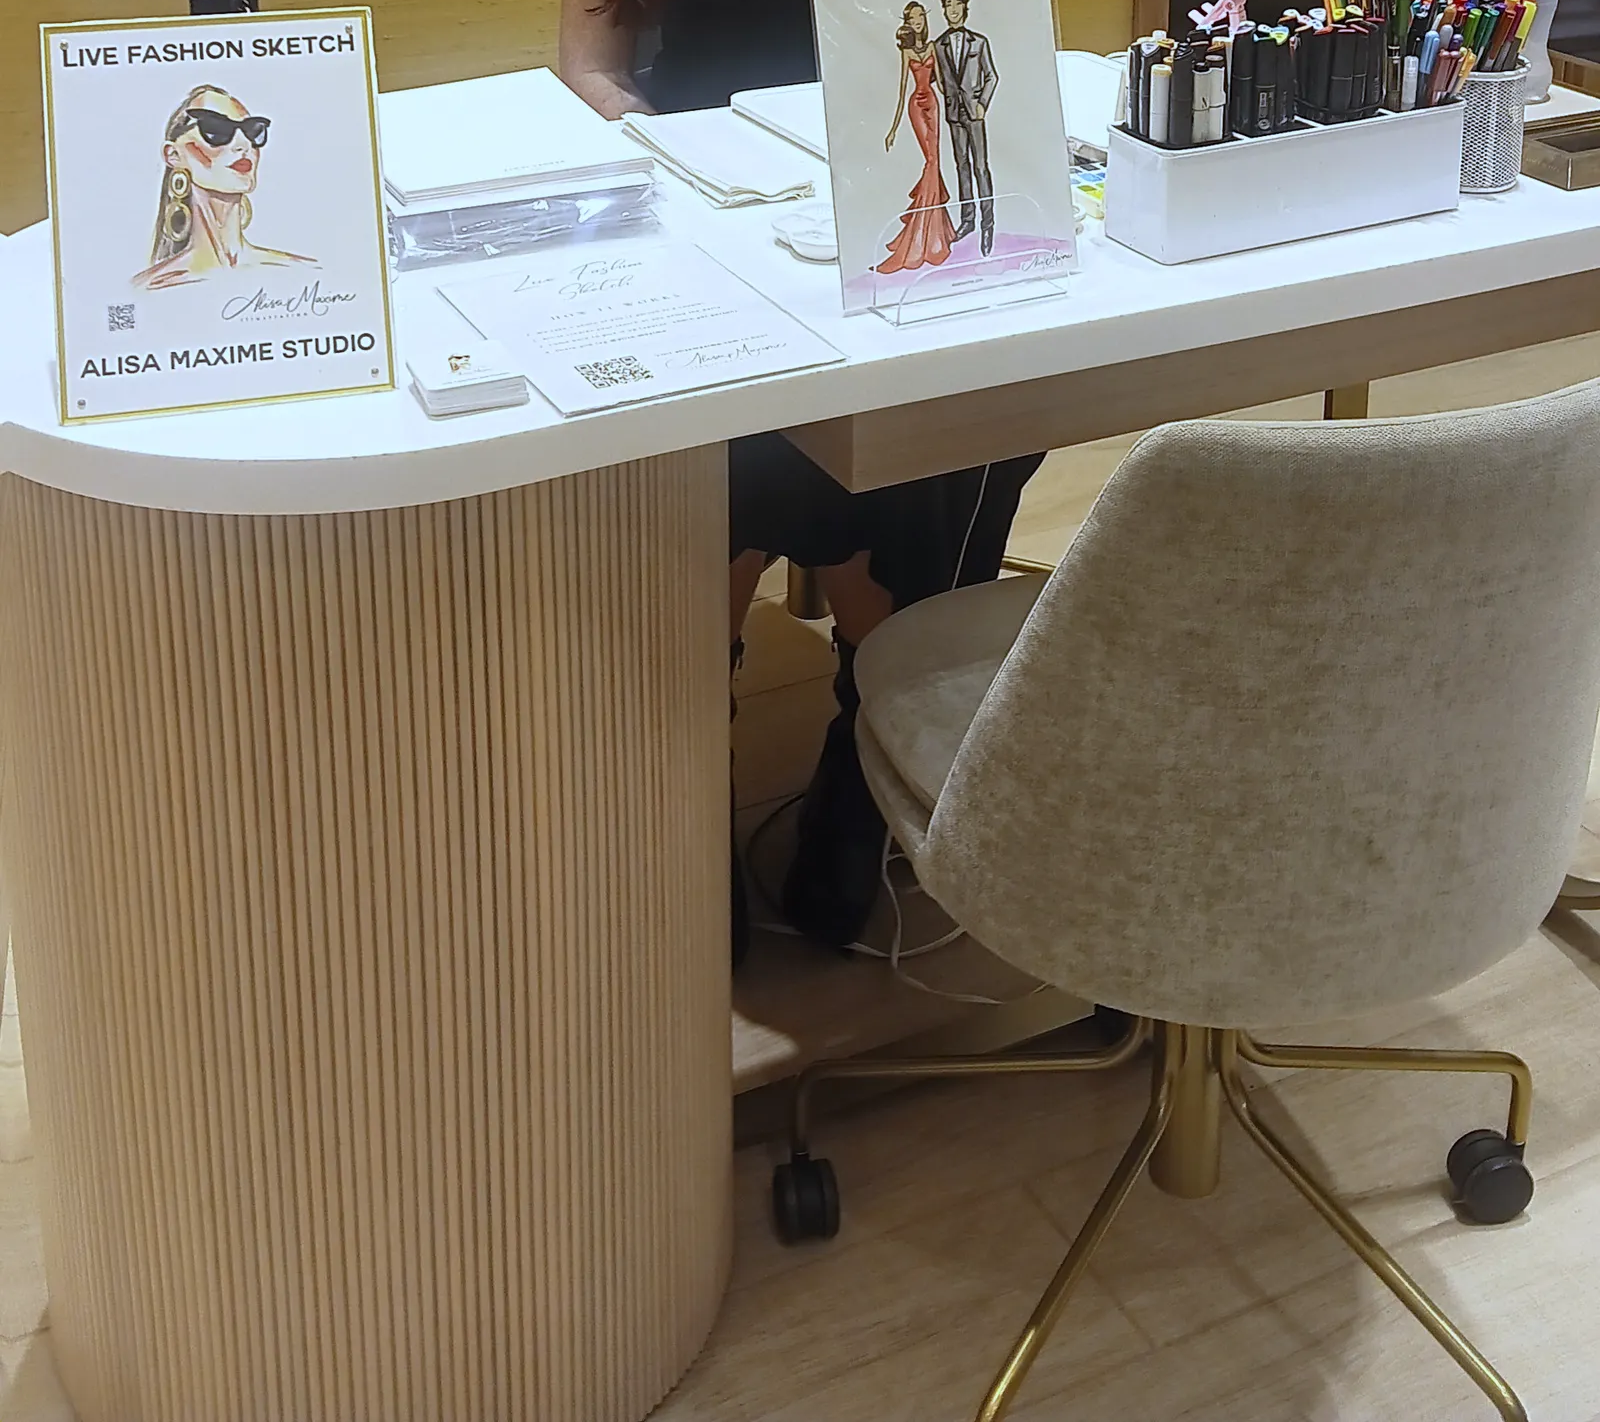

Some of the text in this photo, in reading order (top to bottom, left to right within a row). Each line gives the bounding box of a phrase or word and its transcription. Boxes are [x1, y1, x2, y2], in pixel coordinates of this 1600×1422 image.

[62, 33, 356, 68] LIVE FASHION SKETCH
[80, 332, 376, 378] ALISA MAXIME STUDIO
